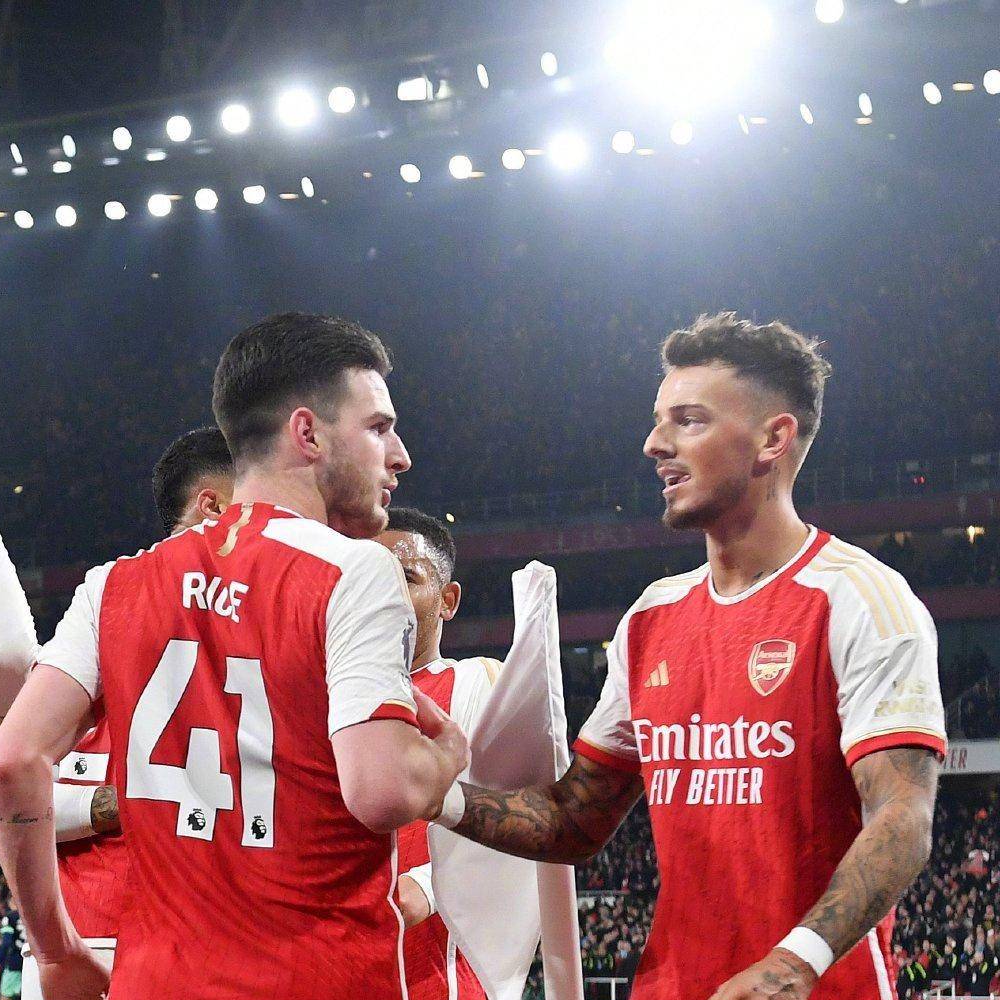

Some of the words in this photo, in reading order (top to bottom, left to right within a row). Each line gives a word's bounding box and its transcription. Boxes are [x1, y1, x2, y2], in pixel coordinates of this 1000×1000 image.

[126, 639, 276, 848] 41
[632, 713, 796, 763] Emirates
[649, 768, 681, 806] FLY
[685, 767, 764, 805] BETTER
